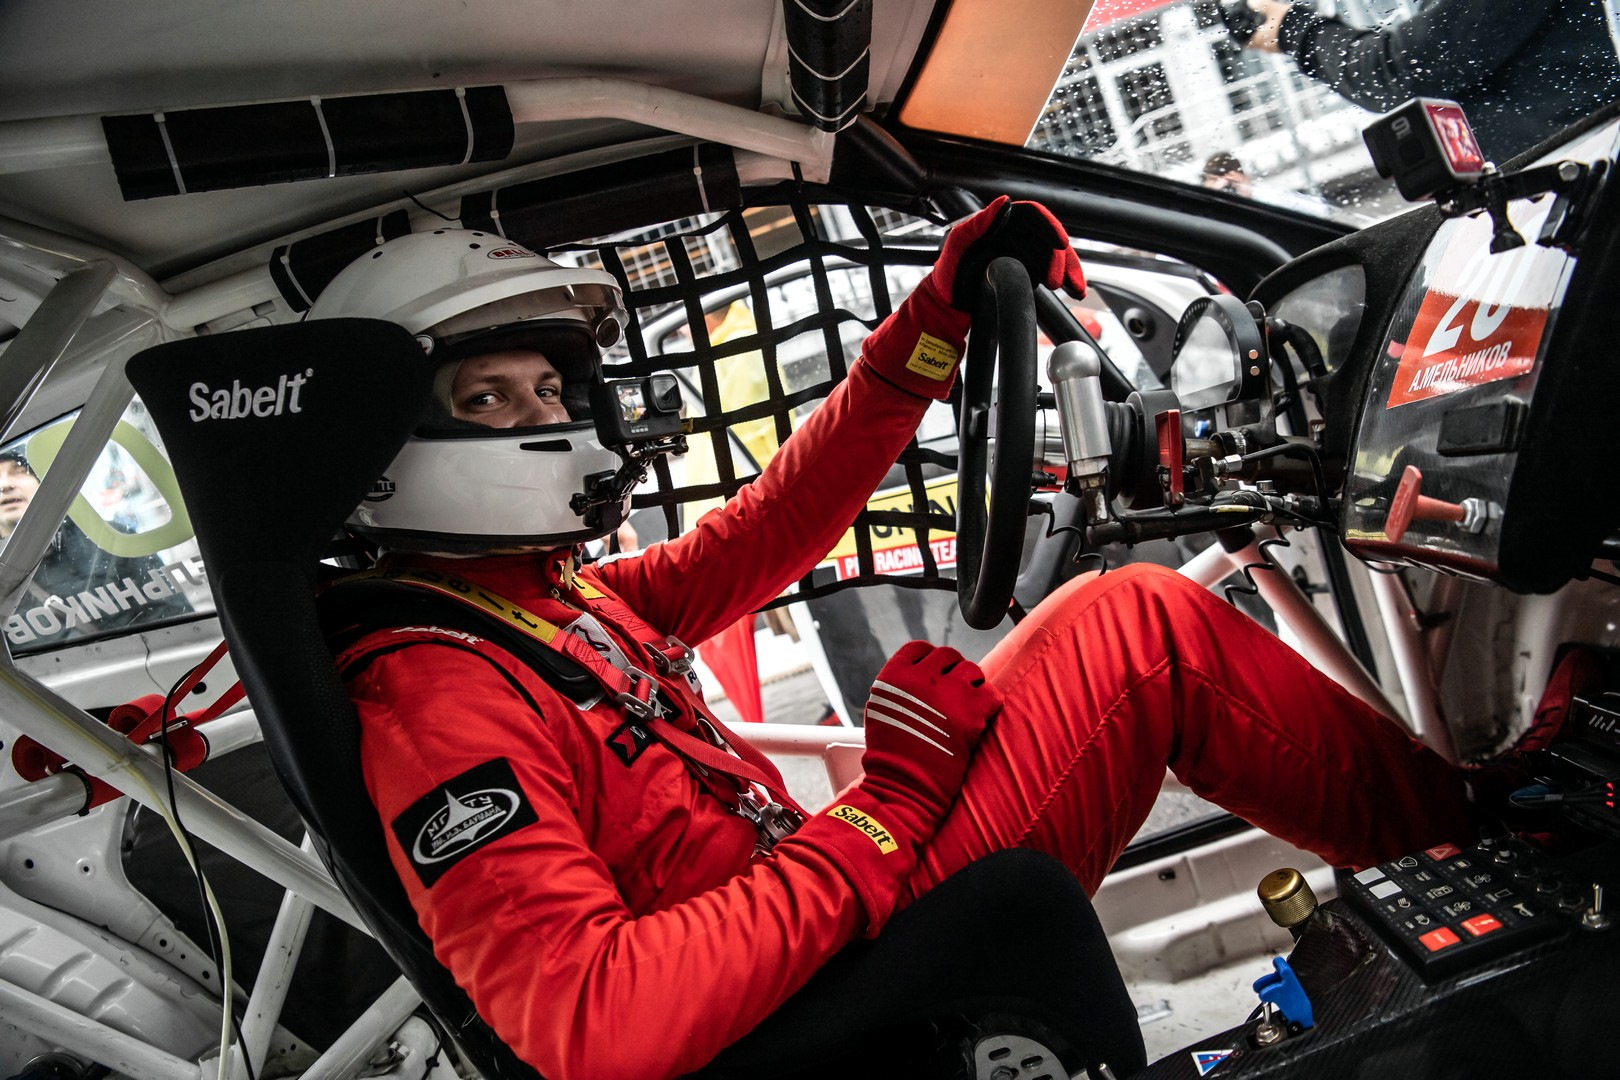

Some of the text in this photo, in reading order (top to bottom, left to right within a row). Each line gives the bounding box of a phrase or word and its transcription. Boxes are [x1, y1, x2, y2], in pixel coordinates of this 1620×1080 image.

[1422, 208, 1549, 358] 20
[918, 352, 949, 370] Sabelt
[835, 806, 891, 846] Sabelt
